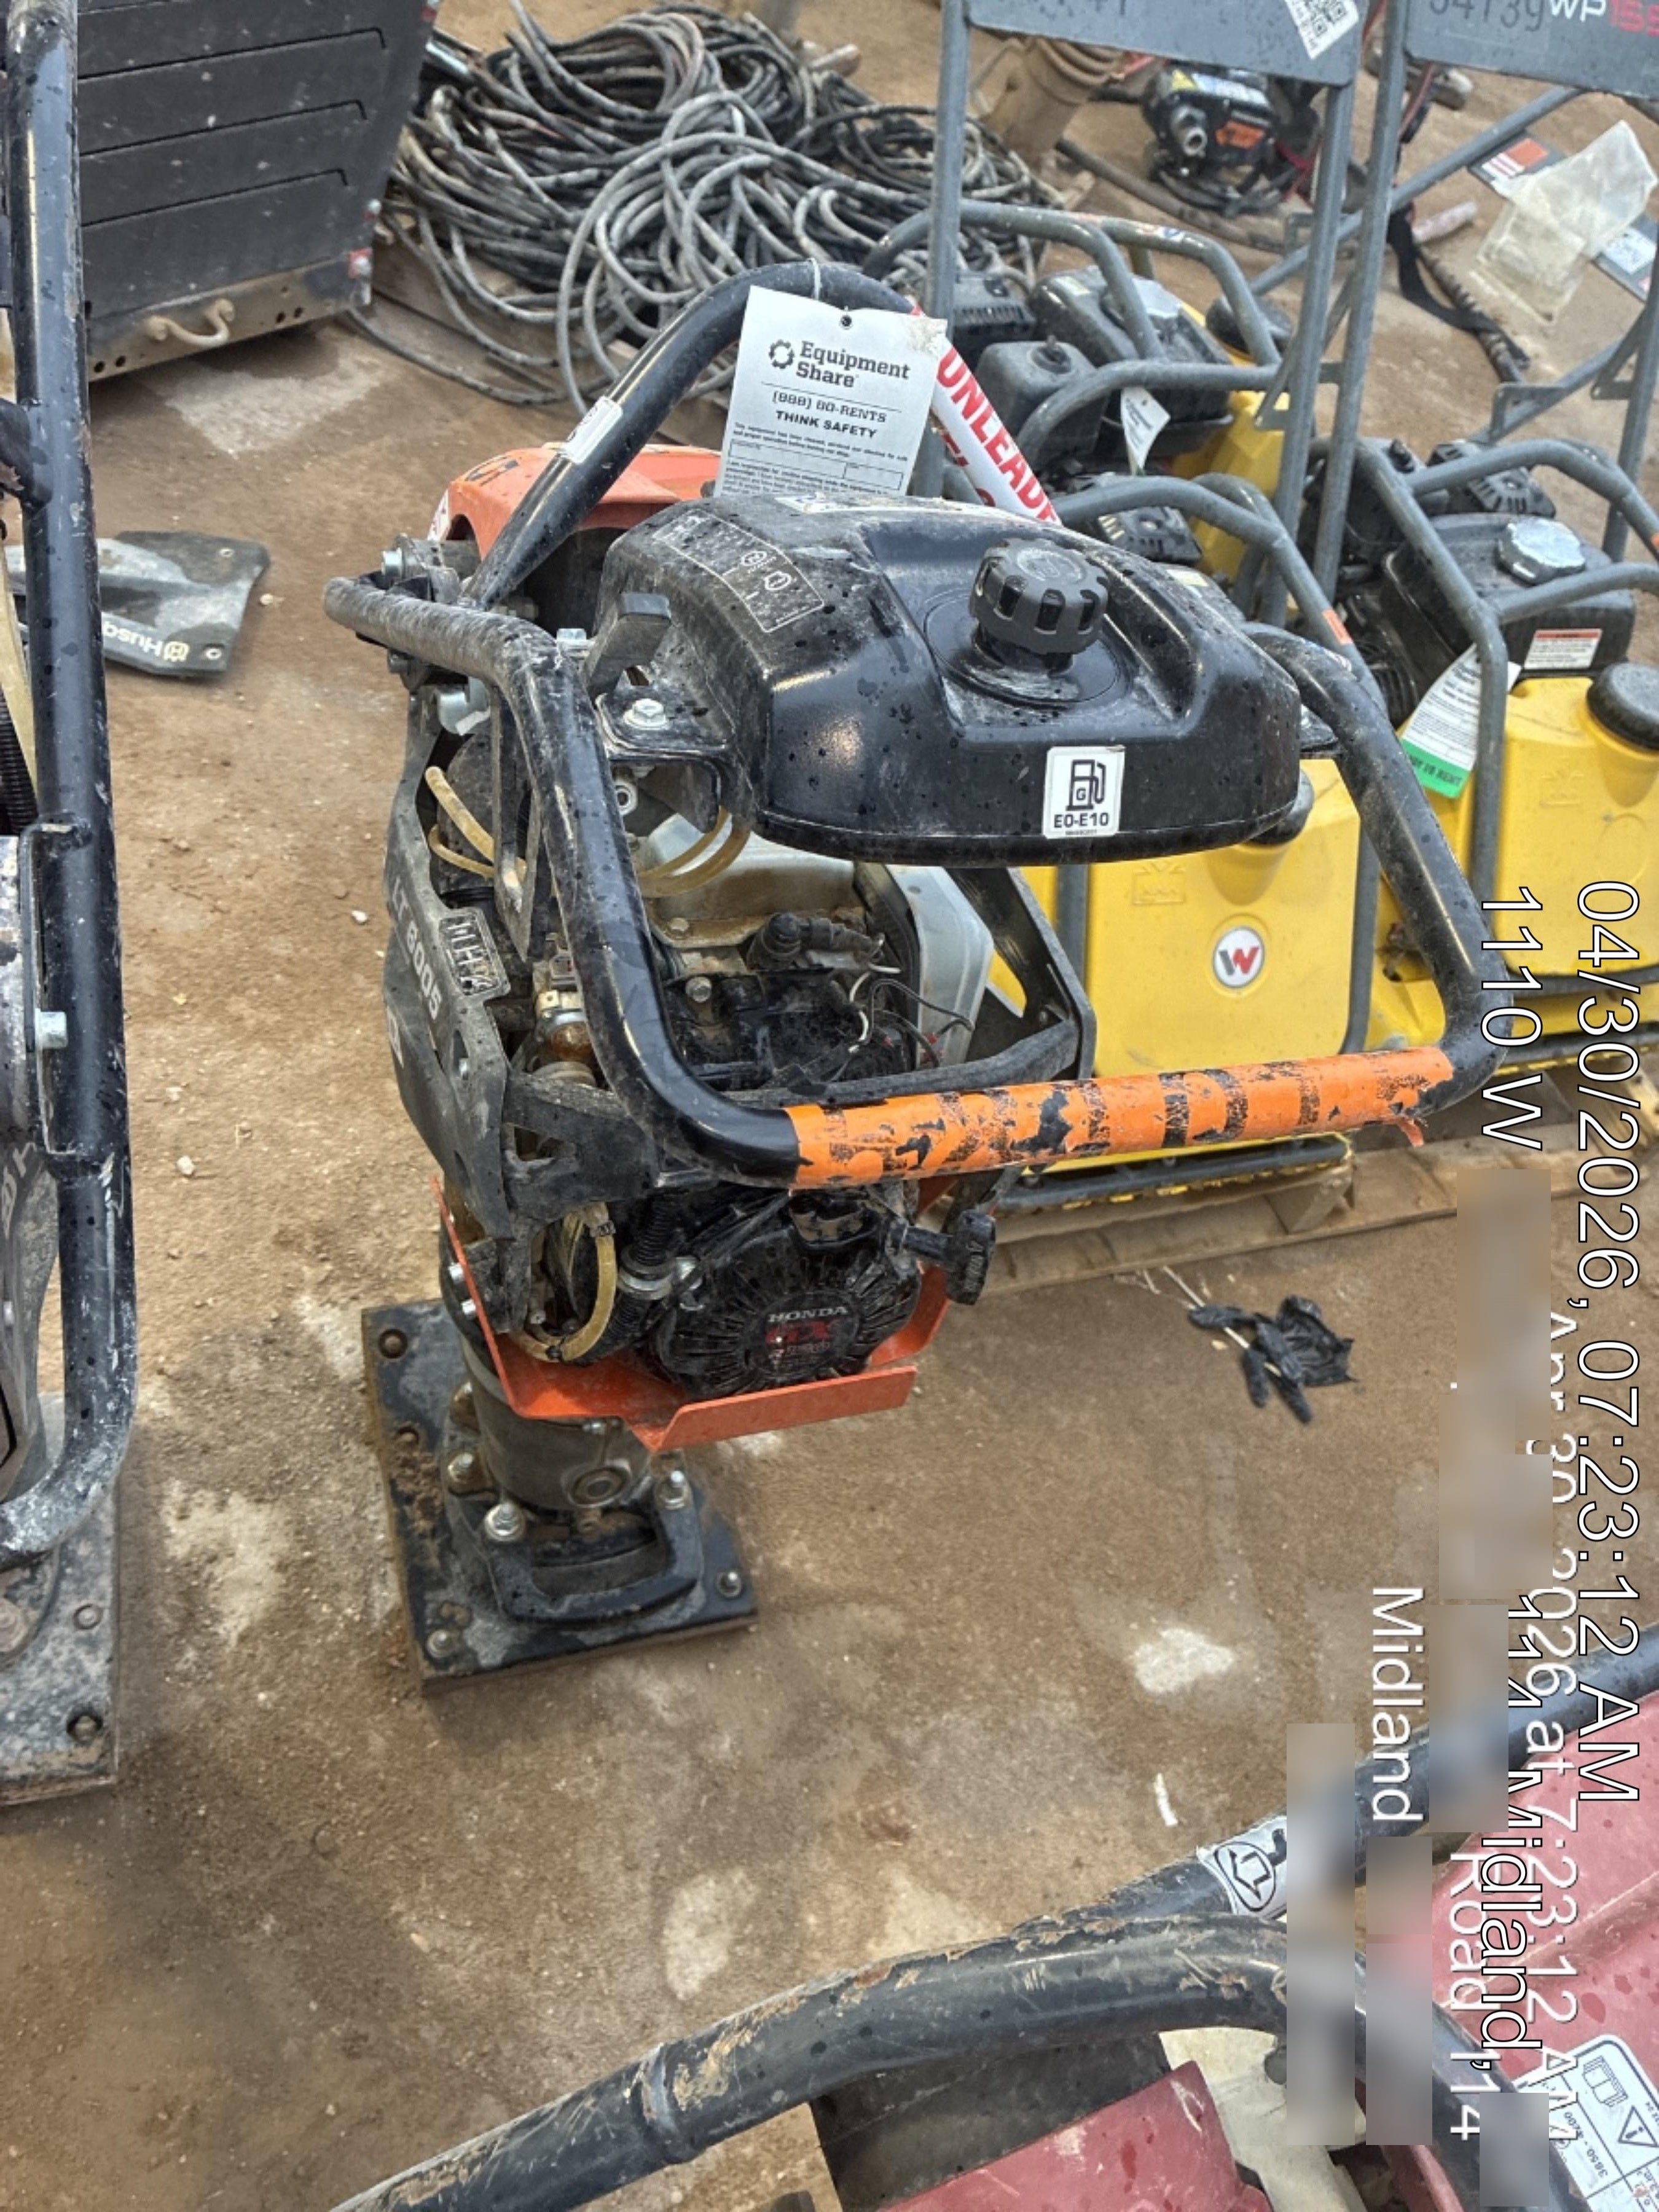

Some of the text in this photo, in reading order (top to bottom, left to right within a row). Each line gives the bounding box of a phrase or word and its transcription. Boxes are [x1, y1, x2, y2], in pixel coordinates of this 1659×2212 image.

[799, 341, 911, 380] Equipment
[796, 363, 855, 388] Share
[772, 391, 812, 409] (888)
[775, 410, 877, 438] THINK SAFETY
[1054, 813, 1108, 828] E0-E10
[767, 1306, 849, 1323] HONDA
